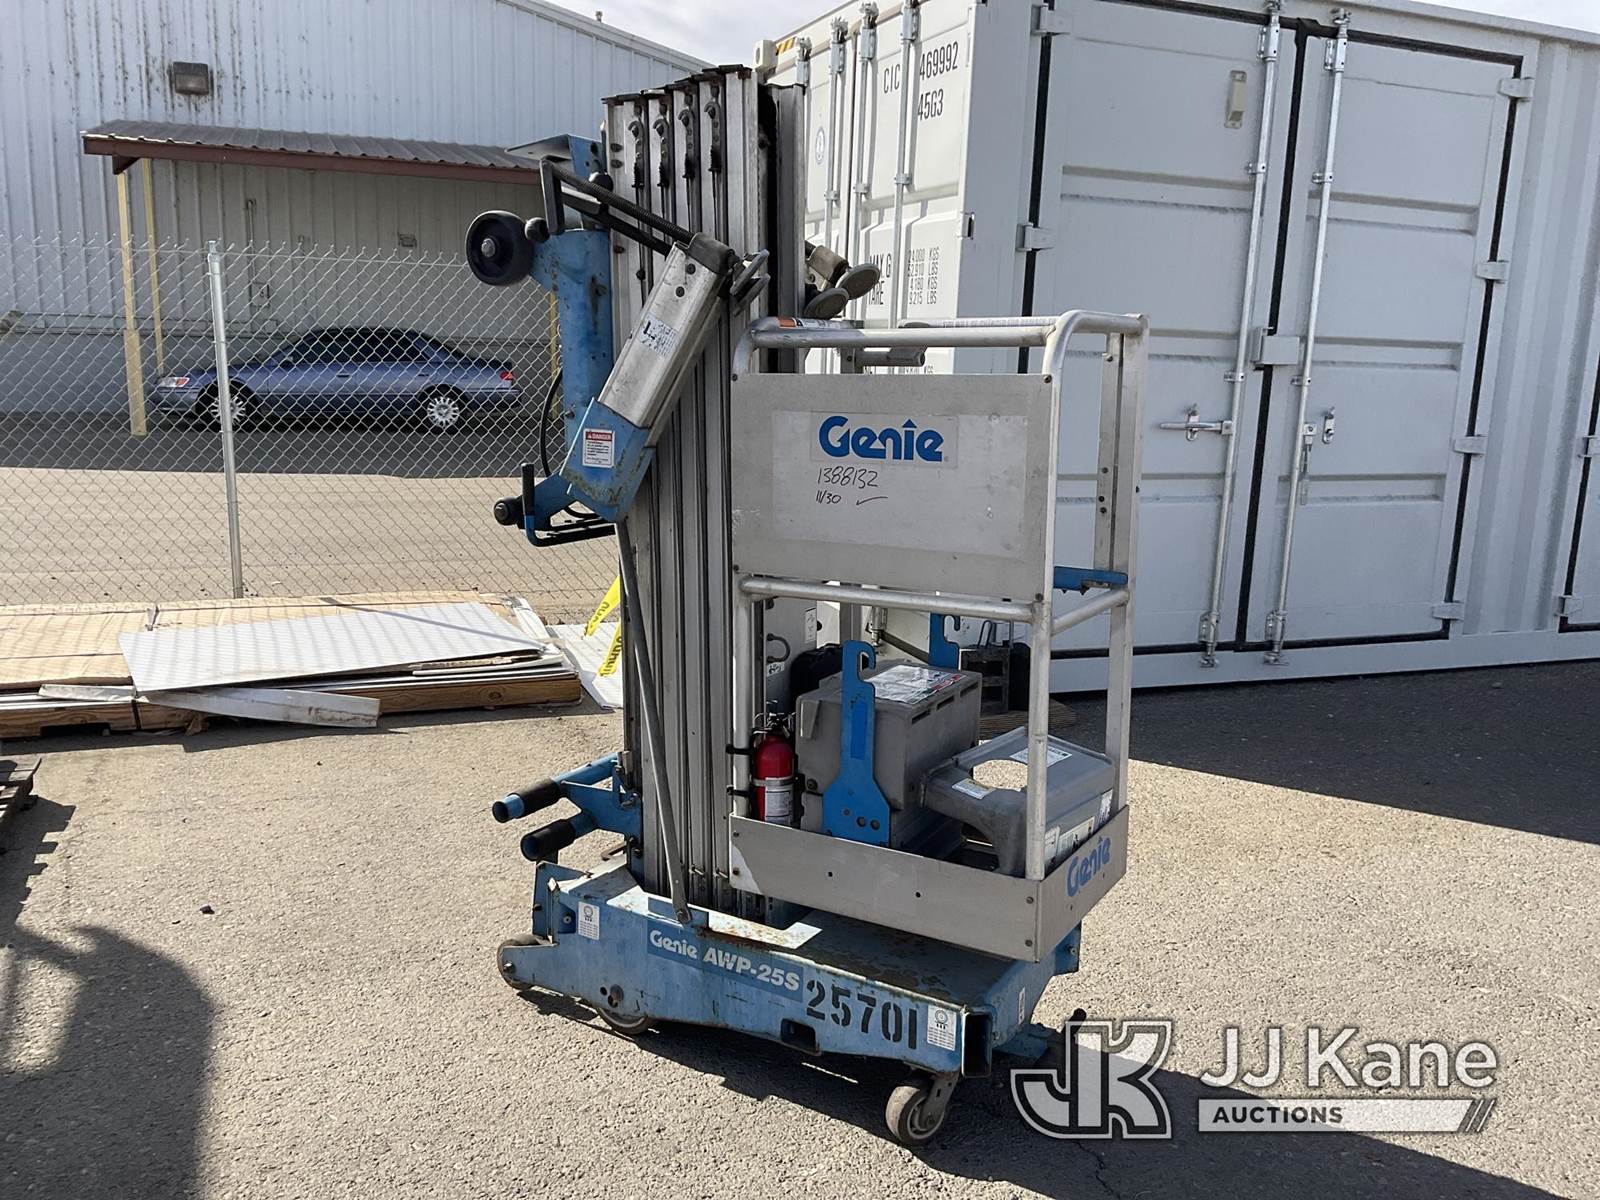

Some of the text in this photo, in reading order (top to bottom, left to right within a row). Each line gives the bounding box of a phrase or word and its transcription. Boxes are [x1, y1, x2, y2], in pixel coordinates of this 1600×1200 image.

[883, 41, 958, 93] CIC 469992
[918, 88, 944, 120] 45G3
[819, 415, 944, 462] Genie
[818, 466, 879, 489] 1388132
[1066, 836, 1111, 897] Genie
[650, 929, 800, 992] Genie AWP-25S
[806, 980, 918, 1050] 25701
